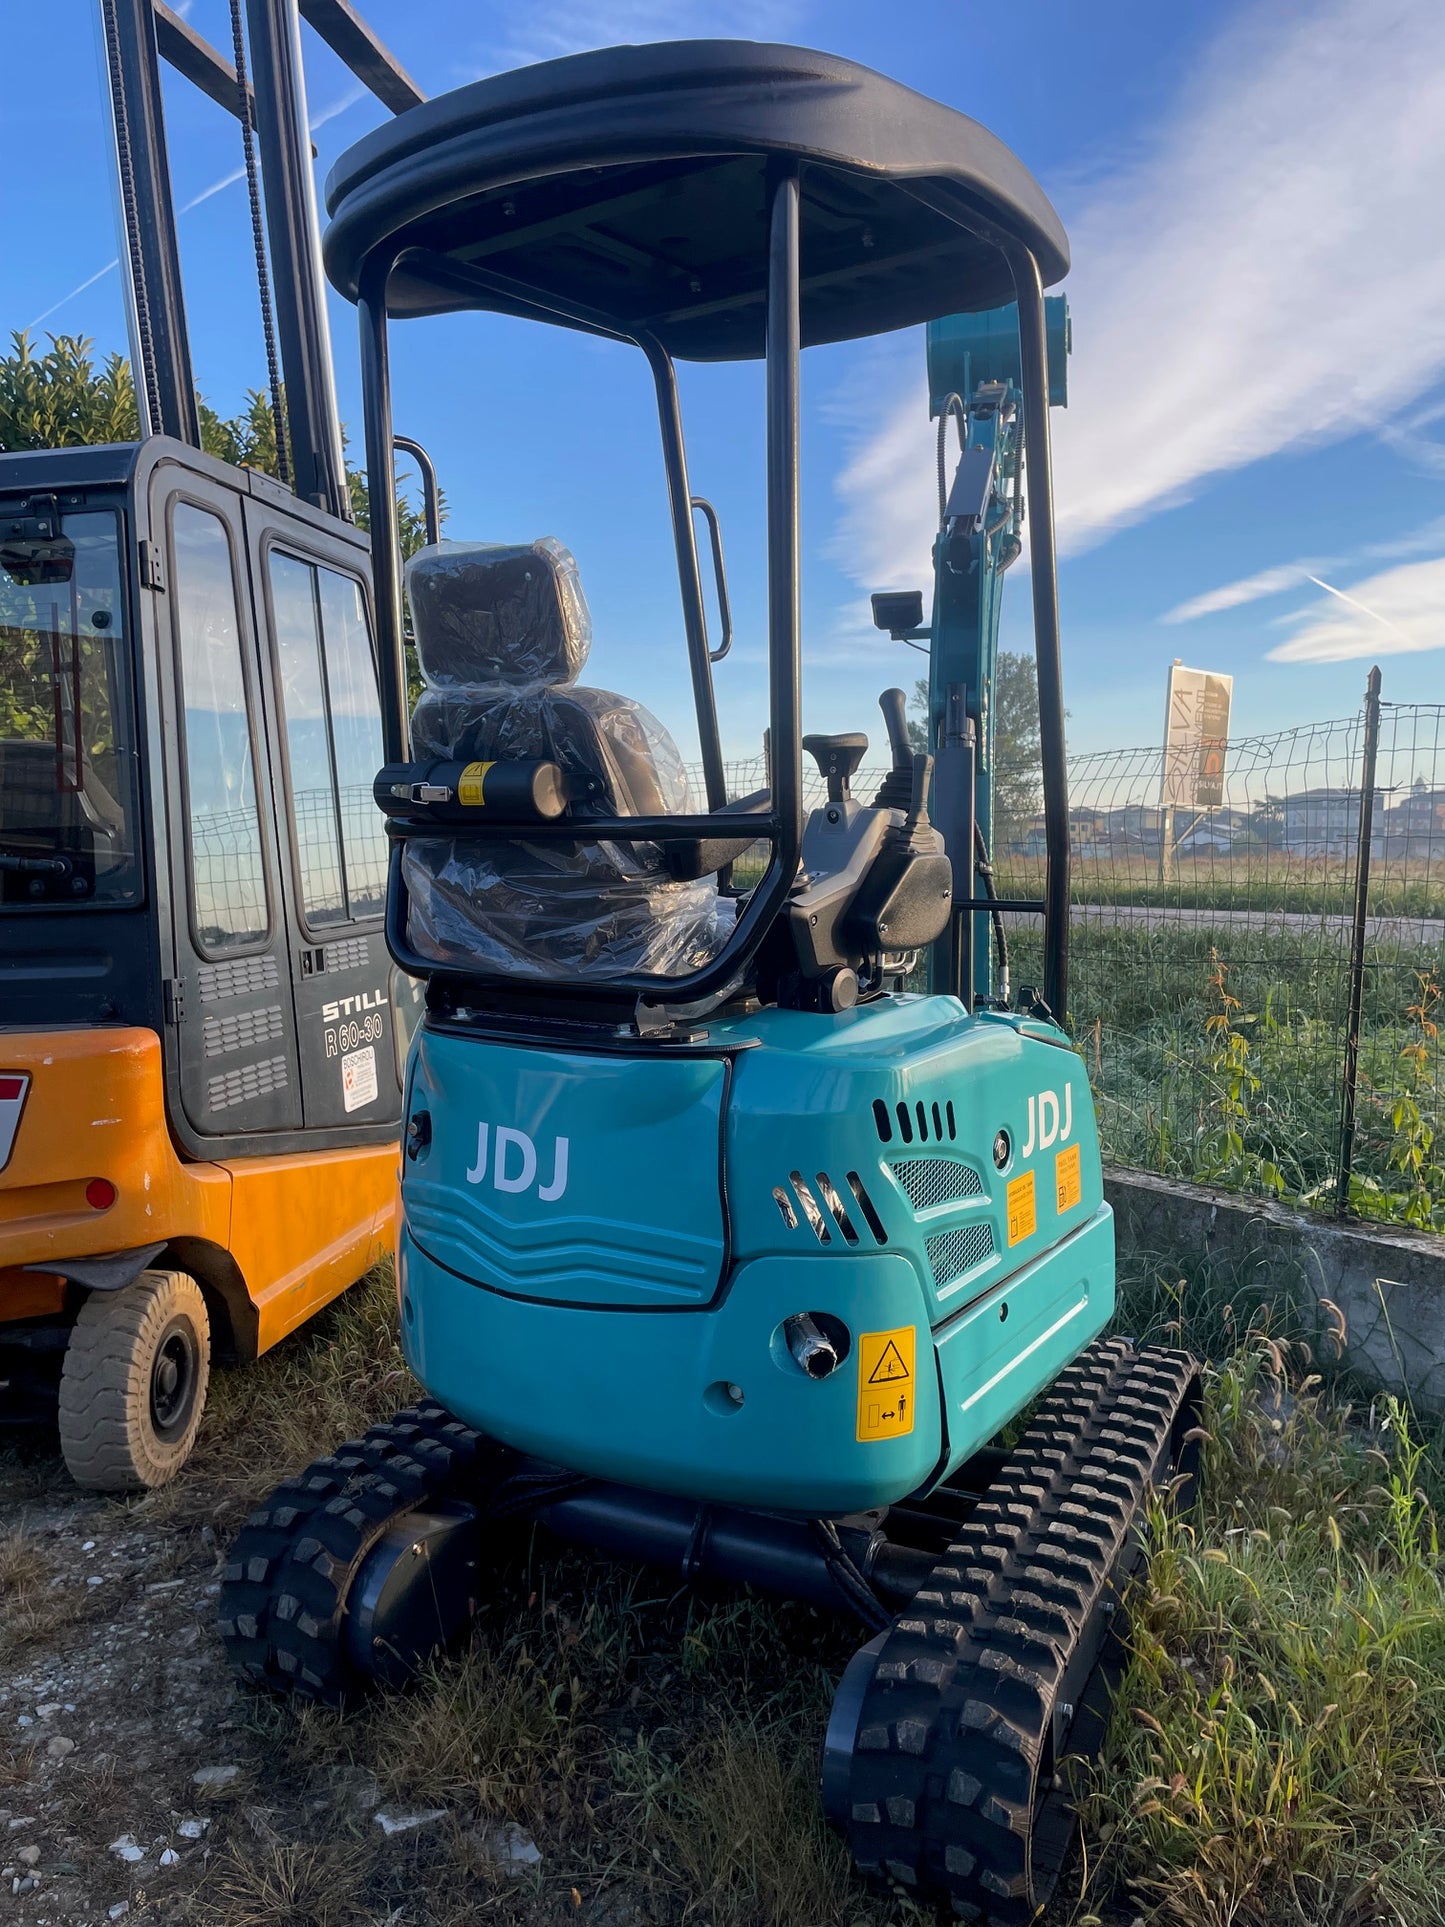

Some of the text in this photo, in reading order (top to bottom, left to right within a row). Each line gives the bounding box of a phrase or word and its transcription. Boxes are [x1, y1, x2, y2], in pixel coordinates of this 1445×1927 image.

[322, 989, 388, 1022] STILL
[1022, 1082, 1072, 1159] JDJ
[466, 1121, 569, 1202] JDJ
